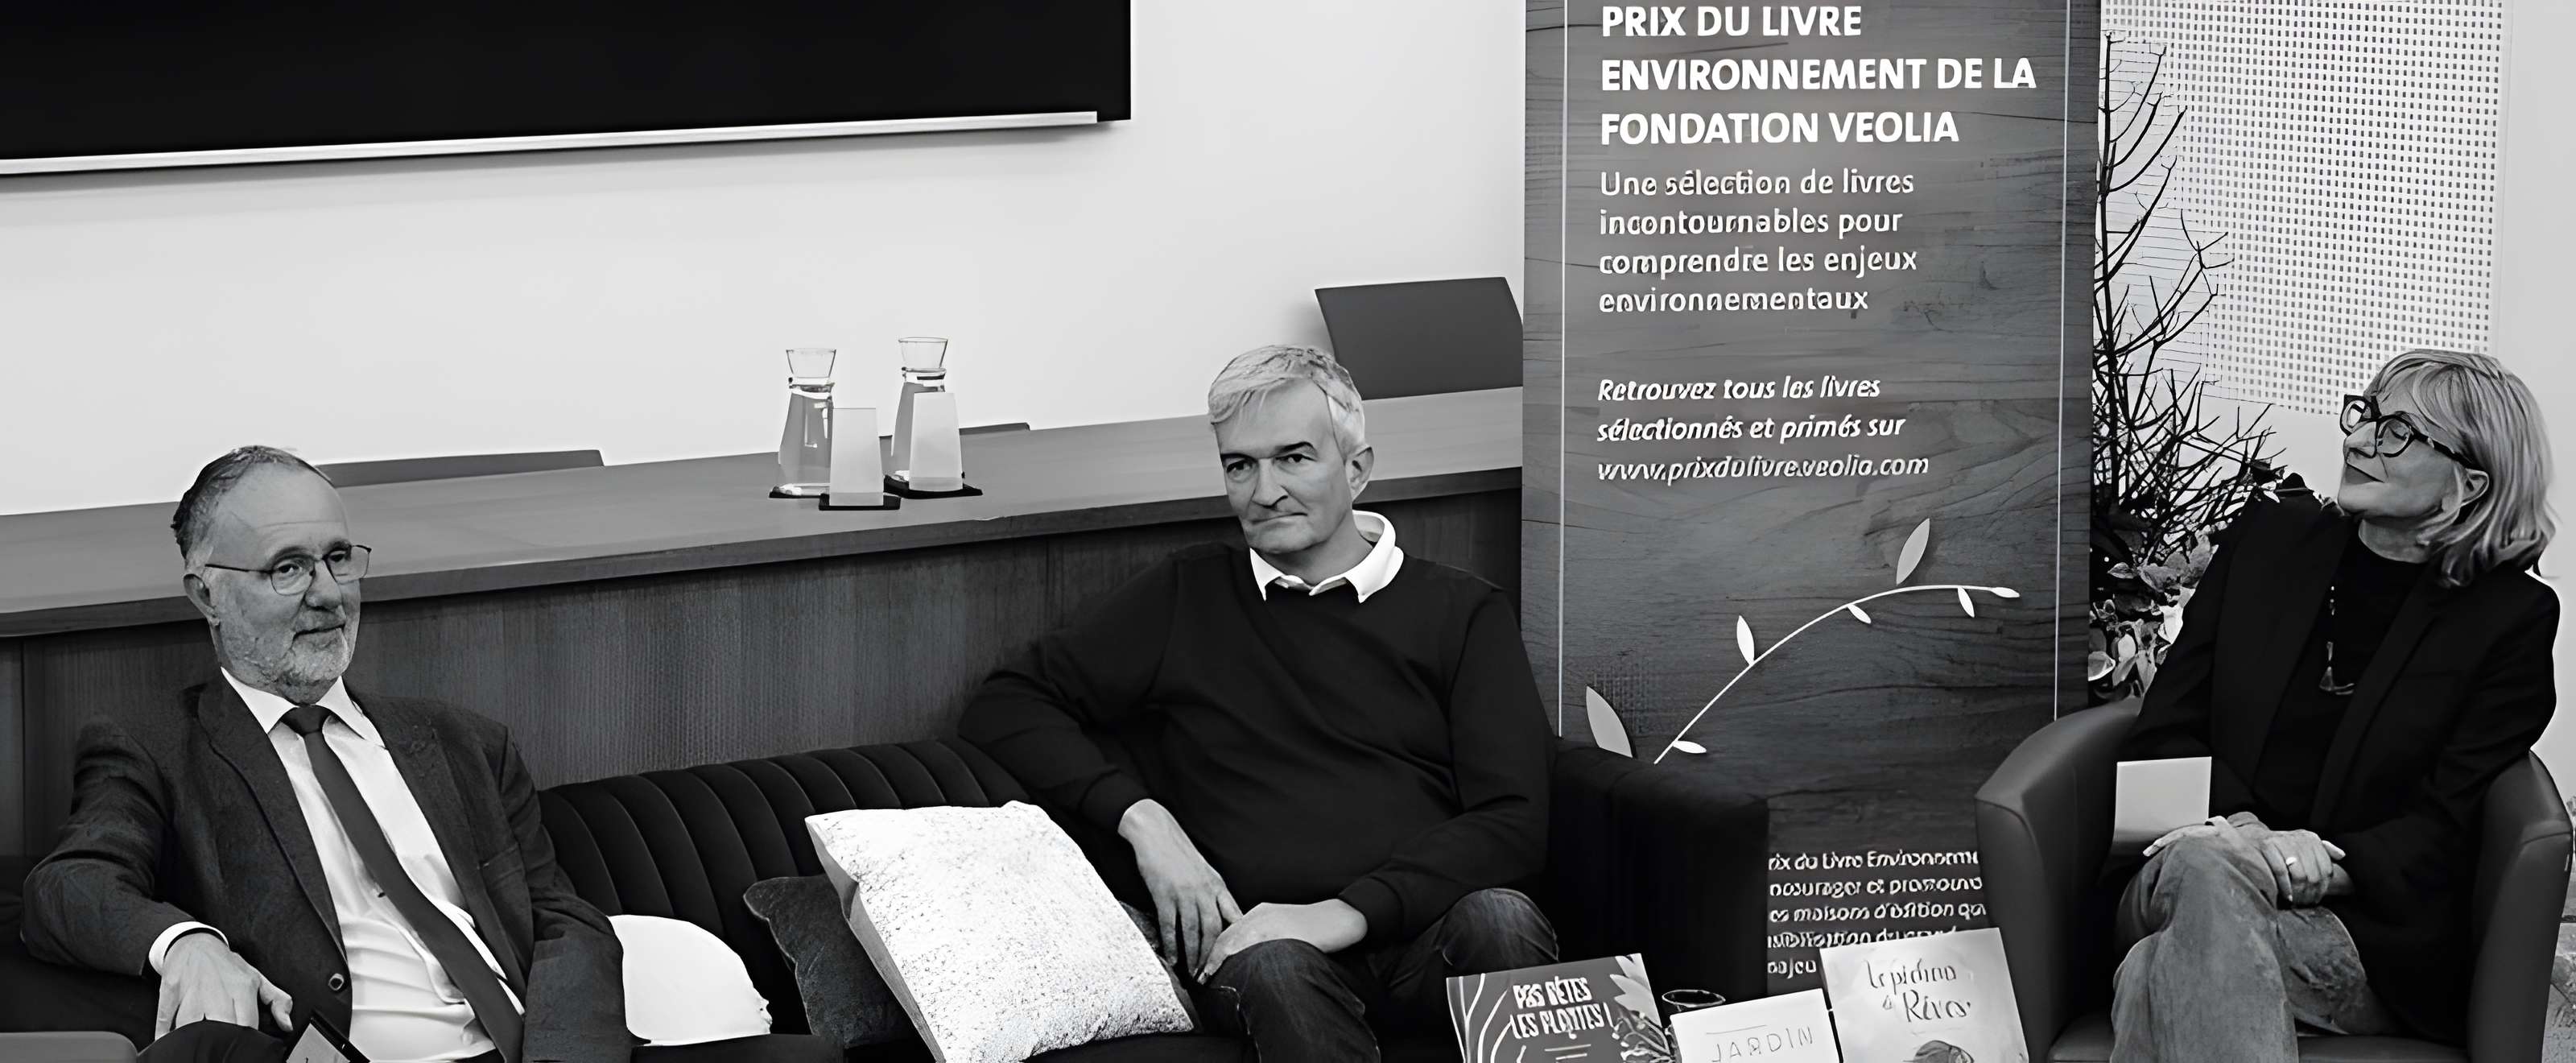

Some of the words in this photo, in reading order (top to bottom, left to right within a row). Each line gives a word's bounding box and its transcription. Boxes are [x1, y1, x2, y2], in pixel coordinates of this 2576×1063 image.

[1602, 6, 1686, 36] PRIX
[1697, 6, 1750, 36] DU
[1762, 6, 1862, 36] LIVRE
[1601, 58, 1927, 91] ENVIRONNEMENT
[1937, 57, 1983, 89] DE
[1993, 57, 2037, 89] LA
[1601, 112, 1818, 146] FONDATION
[1828, 111, 1959, 143] VEOLIA
[1600, 171, 1657, 196] Une
[1665, 168, 1791, 196] sélection
[1799, 168, 1834, 194] de
[1842, 167, 1914, 194] livres
[1600, 207, 1829, 235] incontournables
[1839, 213, 1904, 240] pour
[1599, 246, 1769, 280] comprendre
[1777, 246, 1814, 272] les
[1823, 245, 1918, 279] enjeux
[1599, 286, 1868, 313] environnementaux
[1598, 378, 1716, 401] Retrouvez
[1723, 378, 1776, 400] tous
[1781, 374, 1814, 399] les
[1819, 374, 1881, 399] livres
[1596, 416, 1744, 442] sélectionnés
[1749, 418, 1775, 439] et
[1779, 414, 1861, 445] primés
[1866, 417, 1907, 437] sur
[1598, 453, 1930, 487] www.prixdulivre.veolia.com
